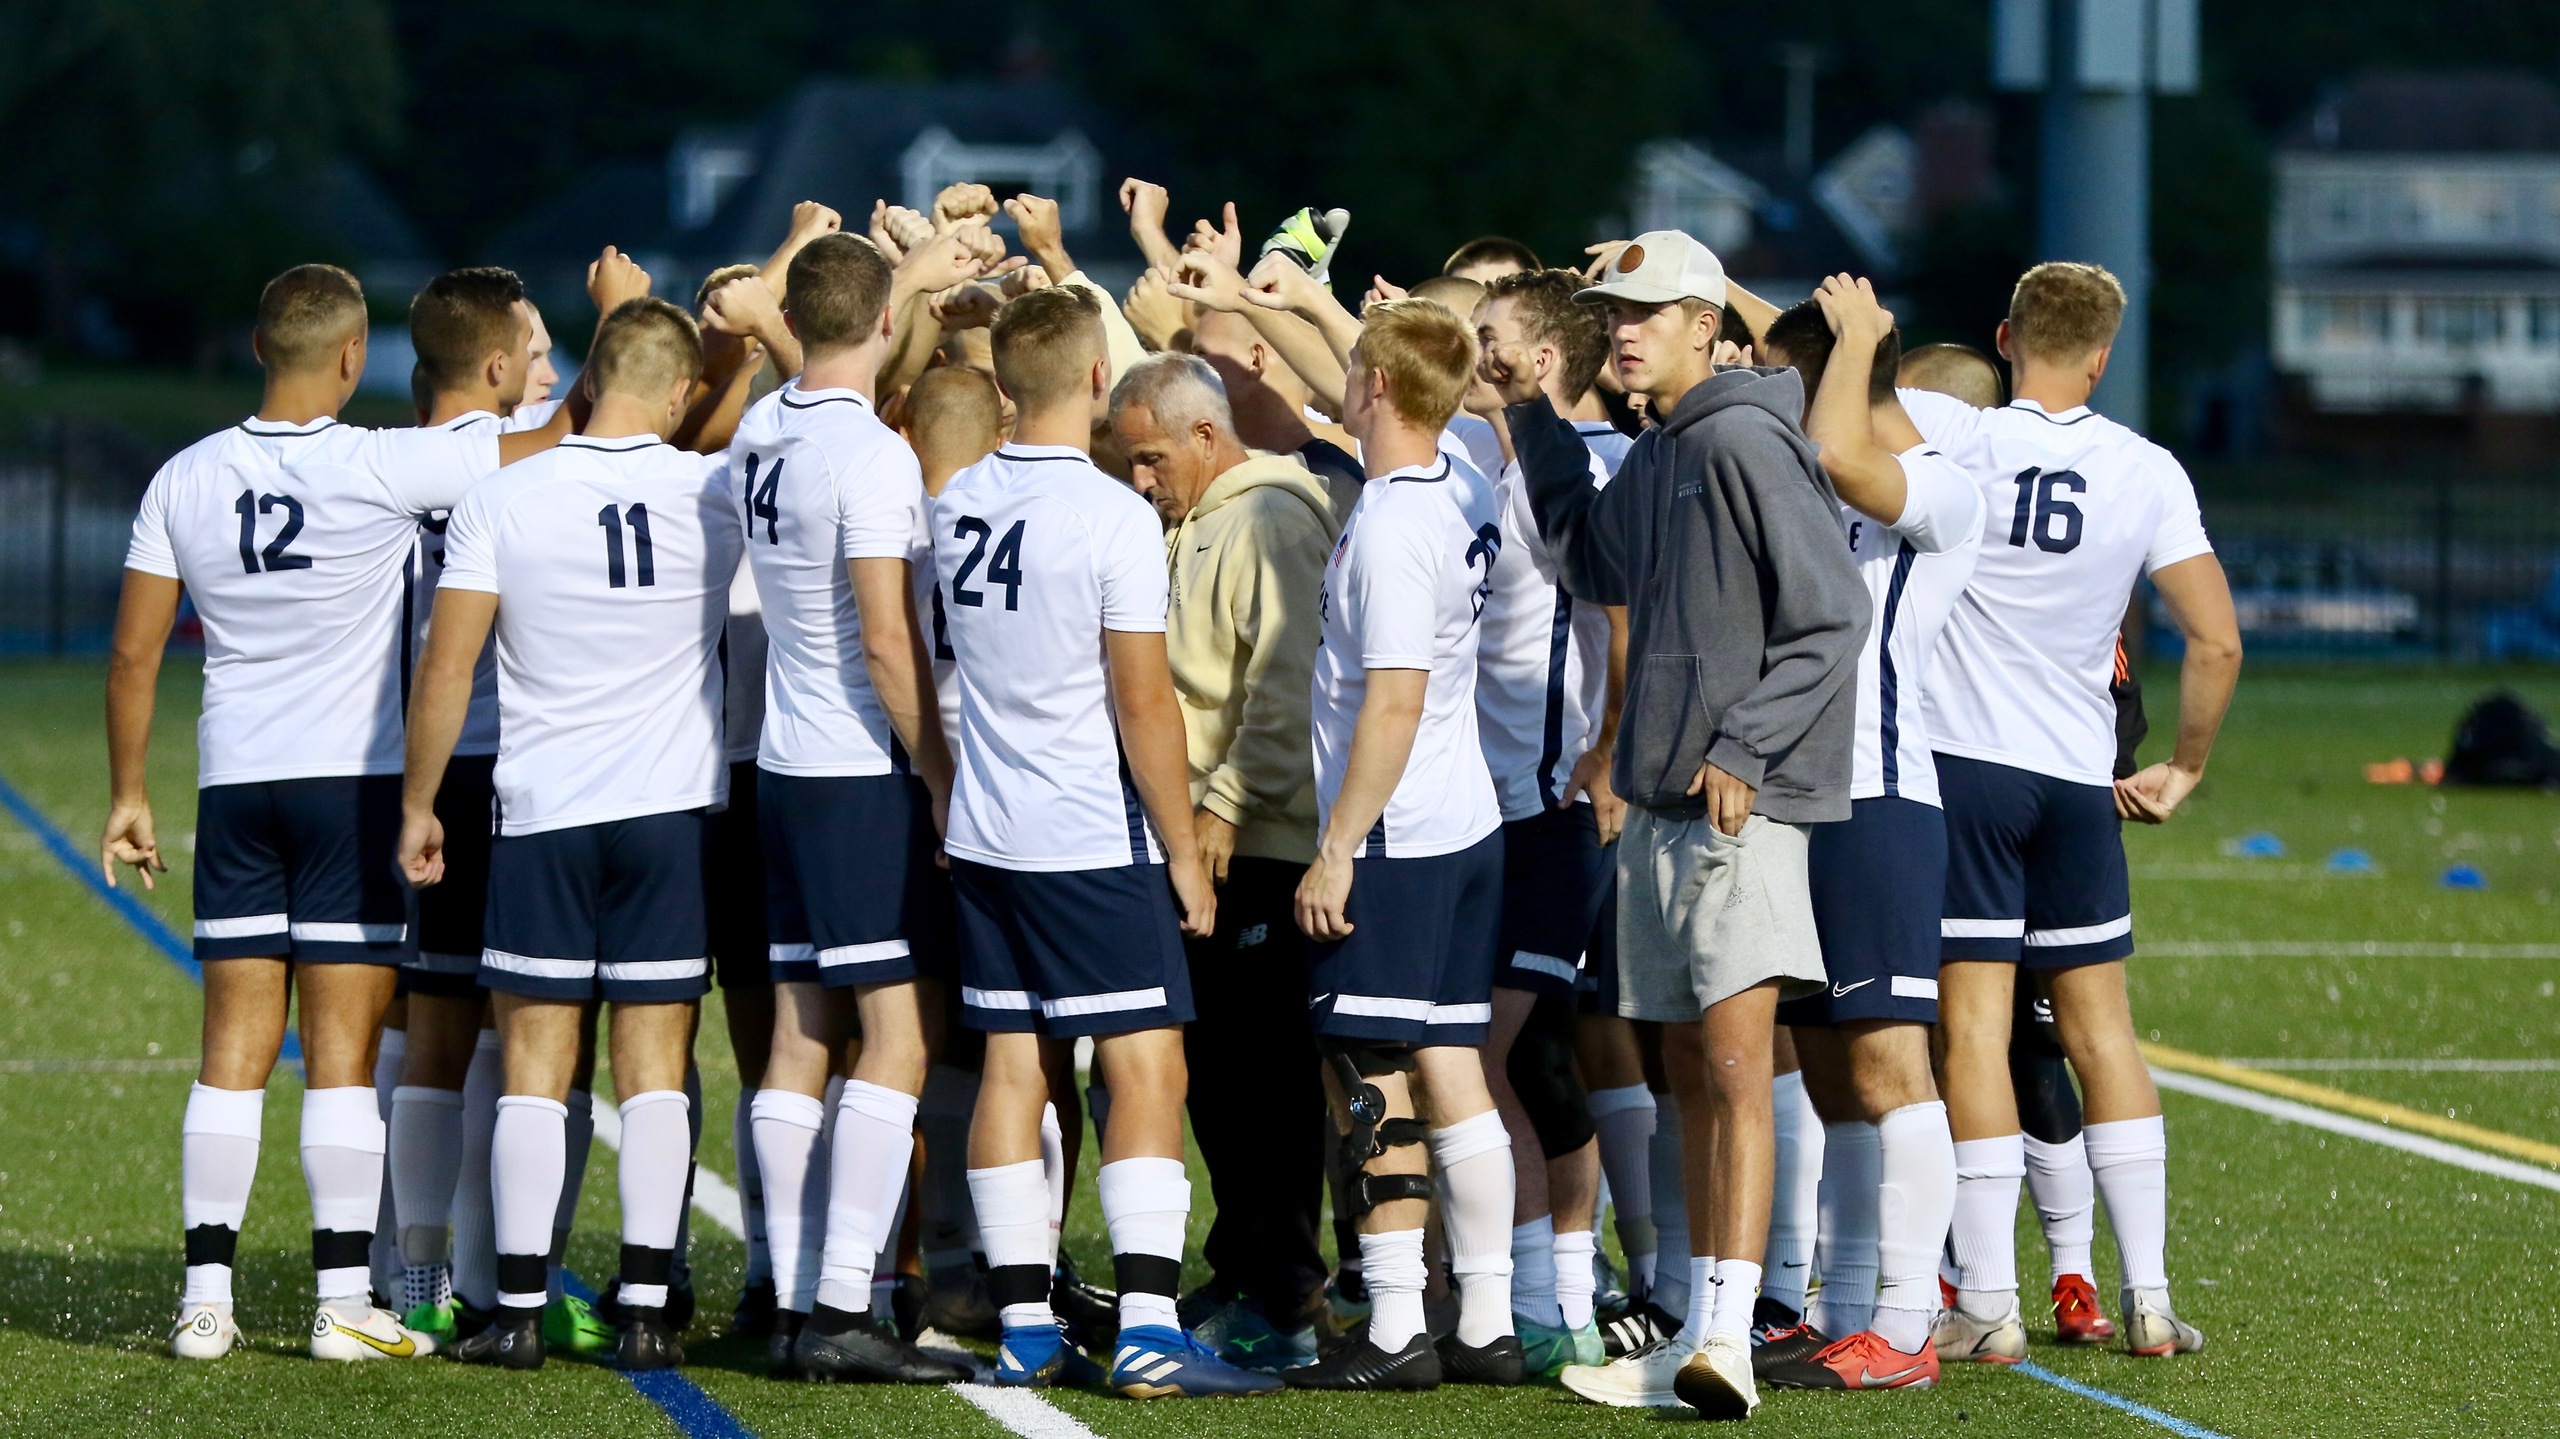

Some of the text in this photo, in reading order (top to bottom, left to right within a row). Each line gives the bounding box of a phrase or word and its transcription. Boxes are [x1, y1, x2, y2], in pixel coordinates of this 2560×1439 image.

[235, 489, 312, 574] 12
[744, 452, 785, 545] 14
[2008, 466, 2087, 554] 16
[598, 503, 655, 588] 11
[952, 514, 1026, 611] 24
